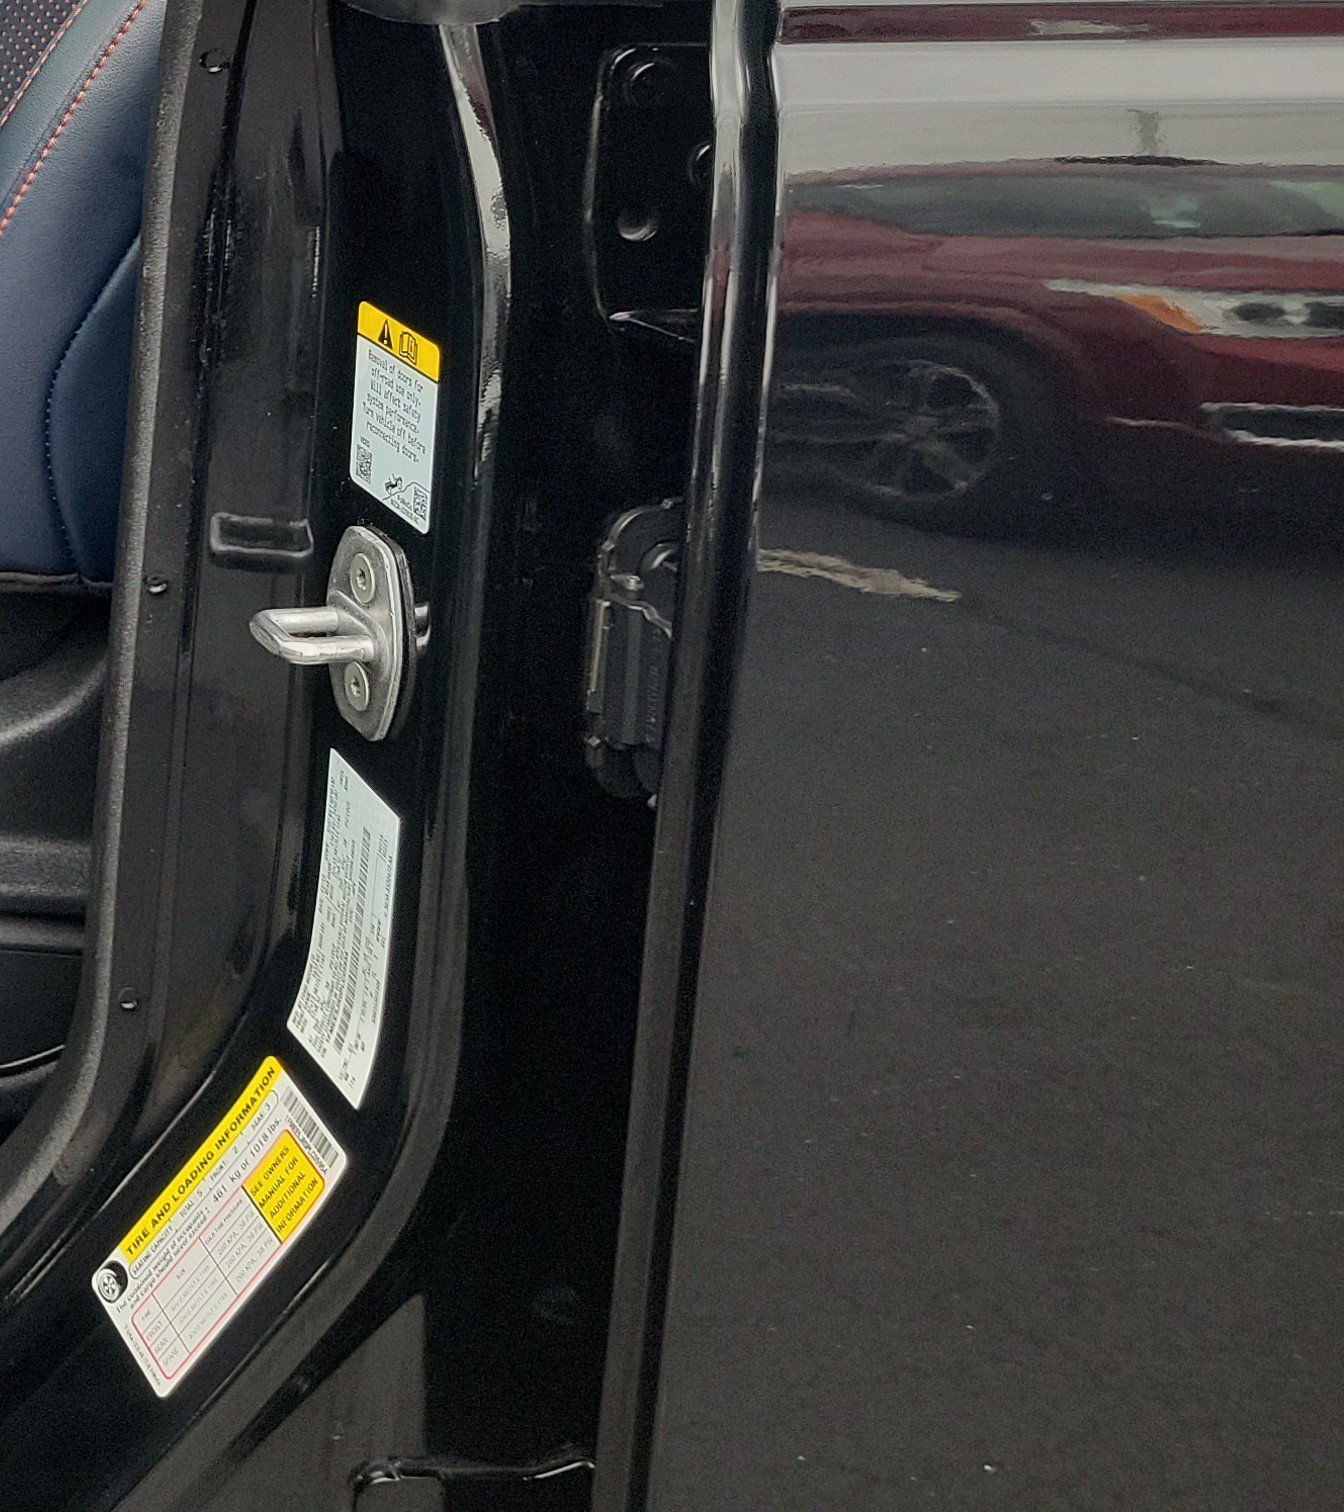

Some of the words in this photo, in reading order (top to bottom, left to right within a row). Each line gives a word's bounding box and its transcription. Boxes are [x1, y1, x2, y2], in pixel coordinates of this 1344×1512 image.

[368, 348, 387, 371] Removal
[388, 361, 395, 376] of
[396, 368, 411, 387] doors
[413, 377, 423, 394] for
[370, 365, 393, 390] off-road
[395, 382, 405, 397] use
[366, 390, 383, 414] system
[383, 387, 401, 409] affect
[402, 400, 421, 424] safety
[361, 400, 374, 419] Turn
[375, 410, 395, 435] vehicle
[396, 424, 405, 441] off
[407, 432, 426, 456] before
[366, 418, 400, 453] reconnecting
[125, 1225, 150, 1258] TIRE
[149, 1199, 172, 1229] AND
[171, 1147, 215, 1204] LOADING
[213, 1065, 276, 1151] INFORMATION
[249, 1177, 264, 1198] SEE
[261, 1144, 291, 1181] OWNERS
[257, 1172, 286, 1209] MANUAL
[283, 1155, 299, 1175] FOR
[267, 1169, 307, 1219] ADDITIONAL
[274, 1176, 320, 1235] INFORMATION
[128, 1293, 140, 1309] and
[210, 1182, 227, 1205] 461
[227, 1166, 242, 1185] kg
[239, 1156, 250, 1171] or
[248, 1130, 271, 1159] 1018
[115, 1298, 127, 1314] The
